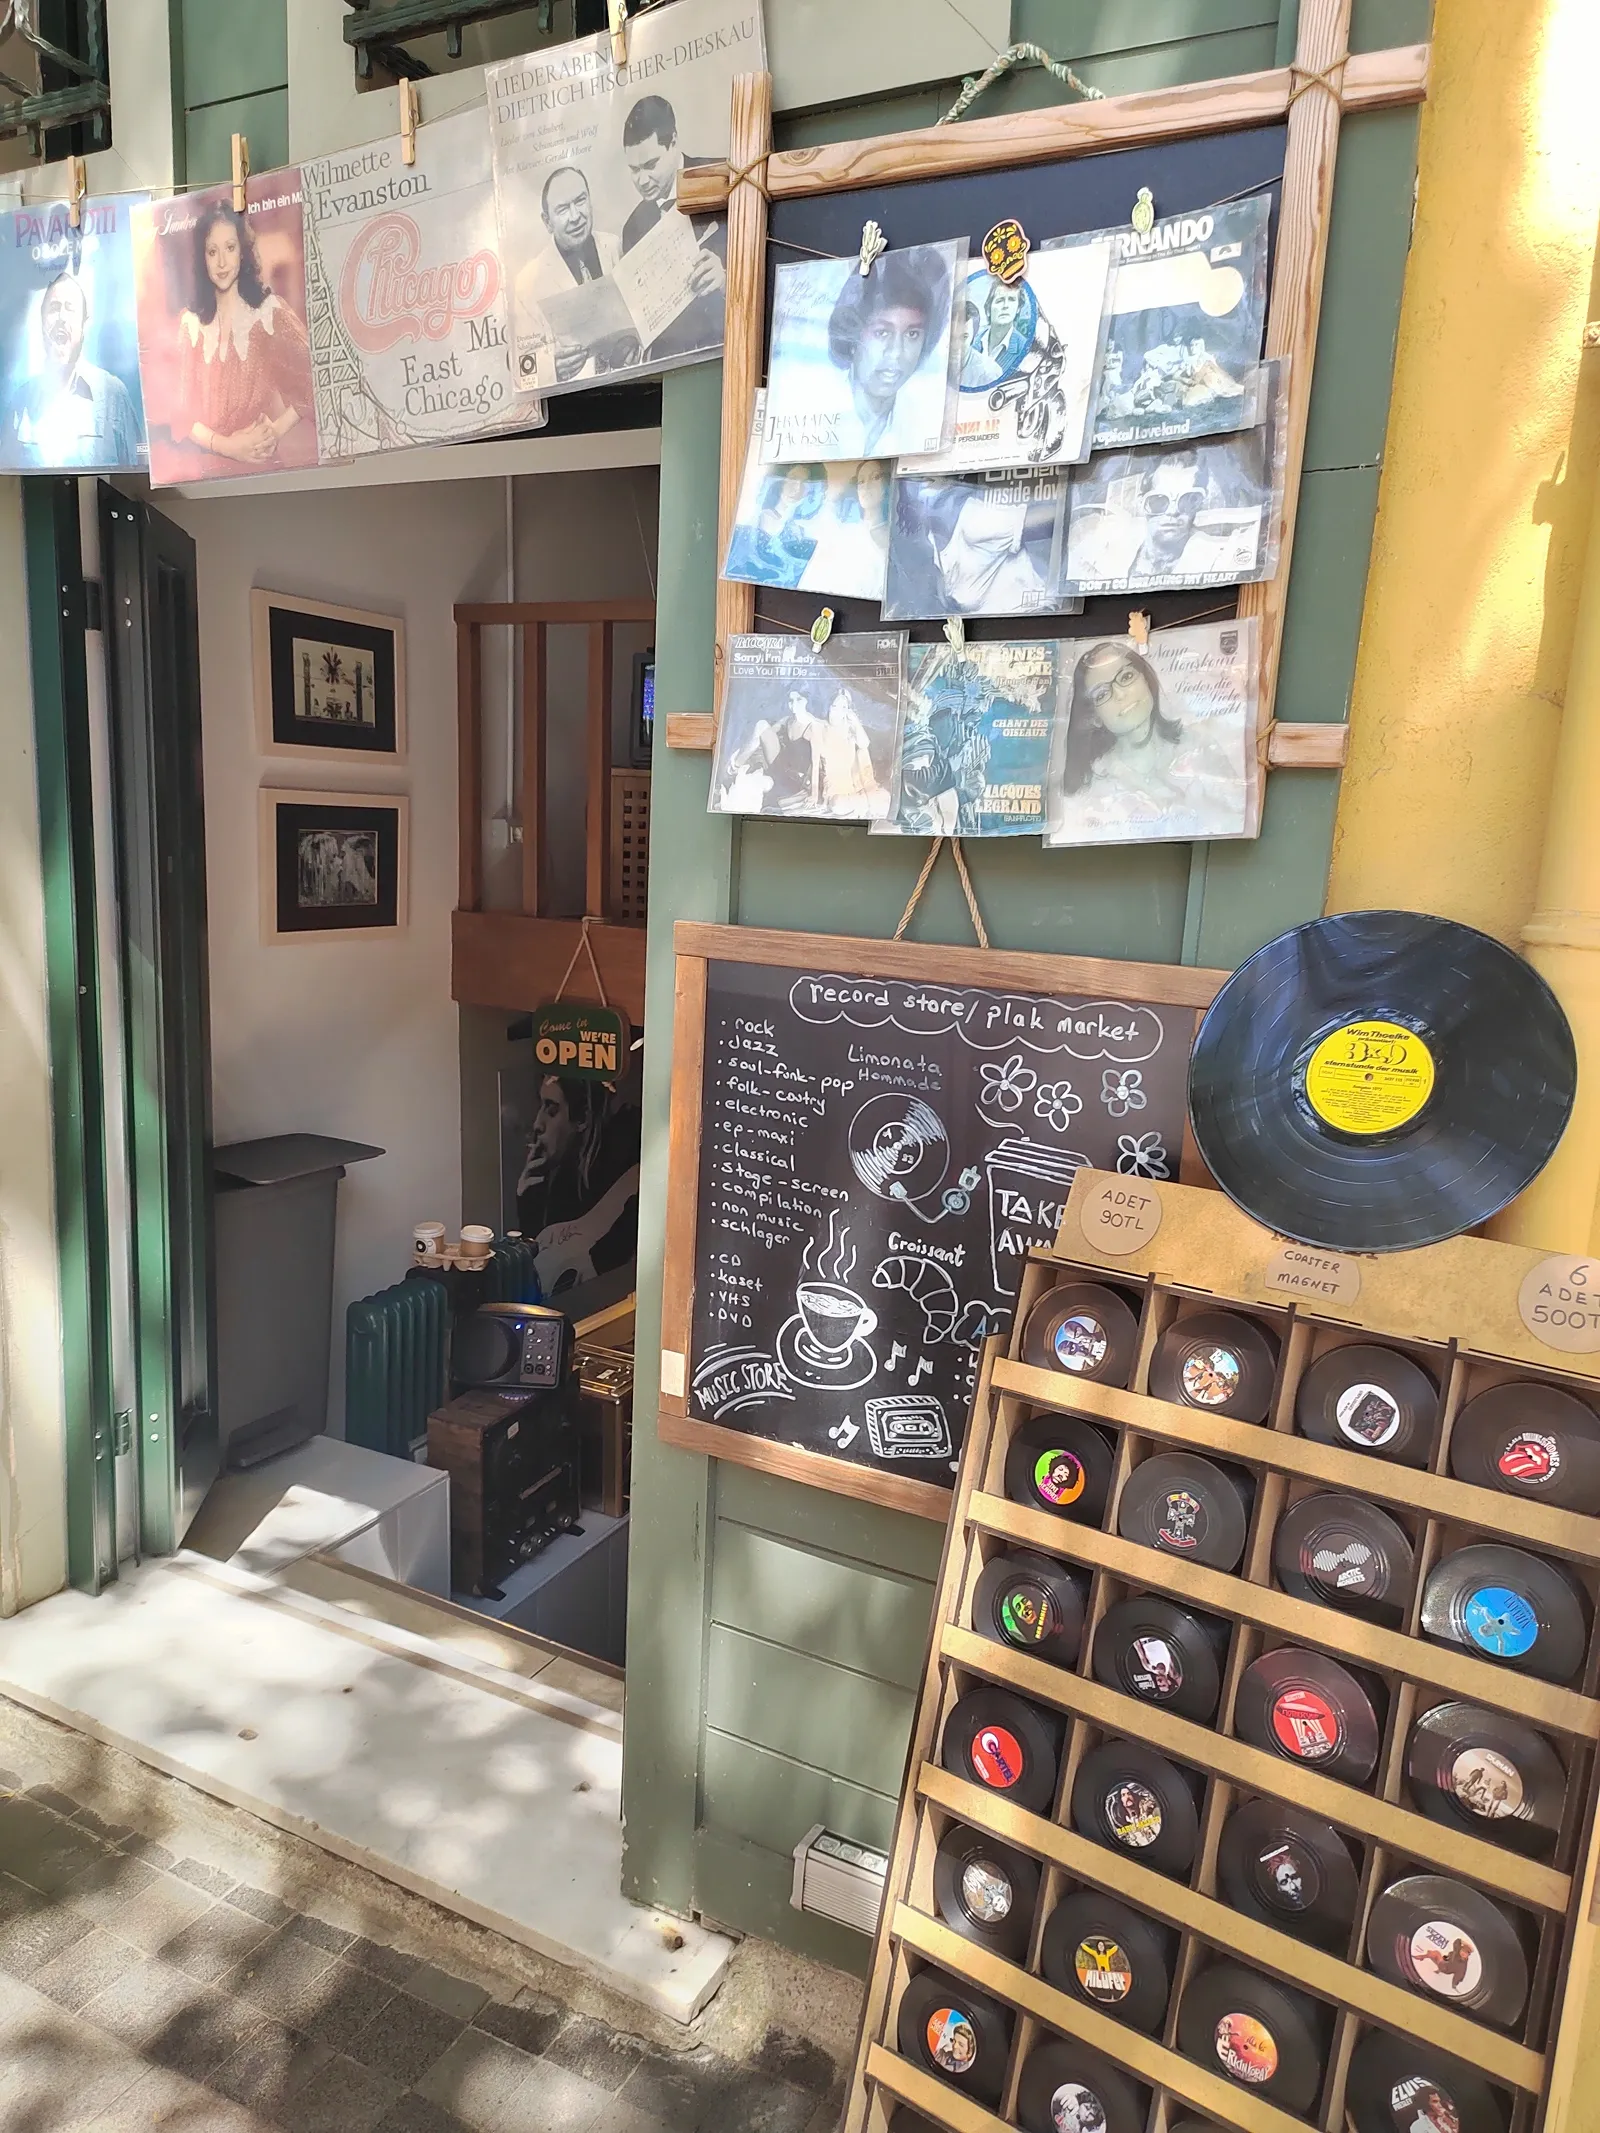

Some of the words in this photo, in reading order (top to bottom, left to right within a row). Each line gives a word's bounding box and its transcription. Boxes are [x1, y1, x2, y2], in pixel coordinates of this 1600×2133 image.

[494, 47, 616, 99] LIEDERABEN
[497, 81, 585, 124] DIETRICH
[590, 16, 756, 97] FISCHER-DIESKAU
[302, 151, 392, 189] Wilmette
[248, 202, 261, 215] Ich
[262, 198, 277, 211] bin
[277, 194, 291, 208] ein
[315, 174, 432, 221] Evanston
[1090, 215, 1215, 259] RNANDO
[339, 212, 500, 355] Chicago
[400, 352, 463, 387] East
[404, 375, 504, 417] Chicago
[958, 432, 1000, 443] PERSUADERS
[1093, 426, 1134, 447] ropical
[1135, 419, 1190, 442] Loveland
[984, 480, 1030, 508] upside
[1112, 577, 1127, 590] GO
[1183, 572, 1202, 585] MY
[1203, 571, 1239, 584] HEART
[733, 666, 754, 675] Love
[755, 666, 773, 676] You
[791, 667, 808, 676] Die
[1161, 652, 1238, 672] Mouskouri
[992, 719, 1029, 729] CHANT
[1031, 719, 1049, 728] DES
[1003, 728, 1048, 738] OISEAUX
[984, 783, 1042, 799] JACQUES
[975, 799, 1042, 815] LEGRAND
[809, 982, 890, 1006] record
[986, 1002, 1044, 1030] plak
[1056, 1015, 1139, 1042] market
[540, 1019, 572, 1037] Come
[580, 1031, 617, 1044] WE'RE
[735, 1018, 776, 1038] rock
[1346, 1028, 1369, 1037] Wim
[1370, 1030, 1411, 1041] Thoelke
[535, 1038, 617, 1071] OPEN
[848, 1043, 943, 1077] Limonata
[1391, 1067, 1420, 1075] musik
[725, 1098, 809, 1128] electronic
[722, 1141, 796, 1172] classical
[722, 1181, 823, 1219] compilation
[1101, 1189, 1152, 1212] ADET
[722, 1201, 749, 1217] non
[756, 1212, 805, 1232] music
[1099, 1209, 1145, 1231] 90TL
[720, 1218, 791, 1250] schlager
[718, 1253, 742, 1267] CD
[887, 1231, 967, 1267] Croissant
[1283, 1250, 1341, 1275] COASTER
[717, 1268, 764, 1293] kaset
[1277, 1272, 1341, 1296] MAGNET
[1569, 1265, 1590, 1287] 6
[718, 1289, 751, 1308] VHS
[717, 1307, 752, 1328] DVD
[694, 1368, 741, 1411] MUSIC
[741, 1361, 793, 1394] STORE
[1484, 1753, 1515, 1778] DUMAN
[1390, 2075, 1432, 2106] ELVIS
